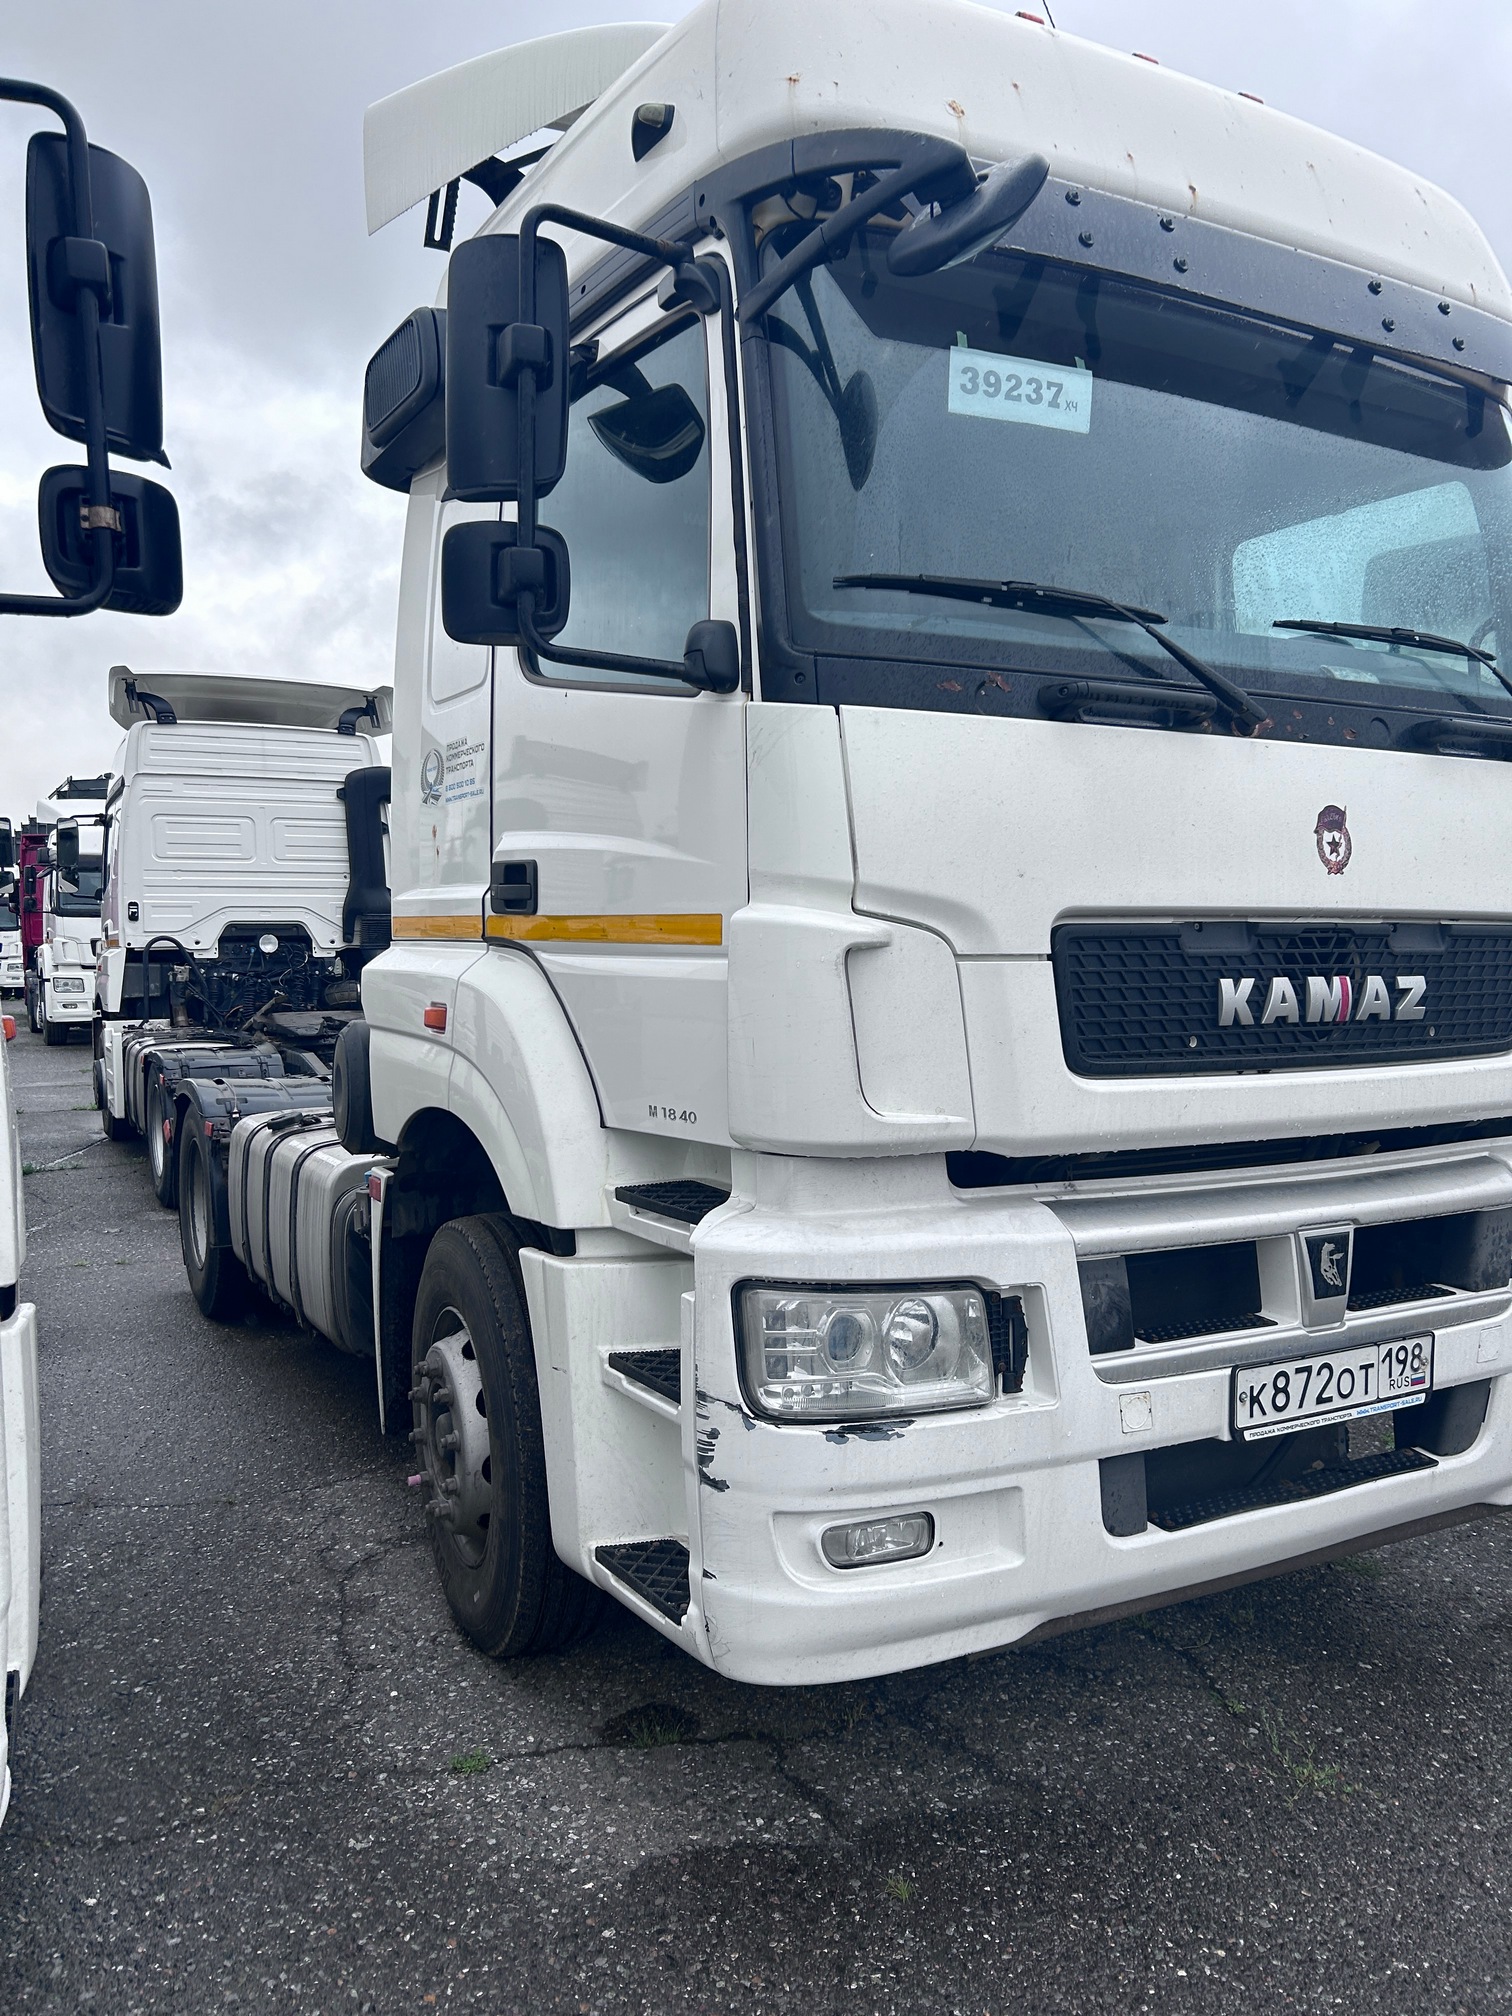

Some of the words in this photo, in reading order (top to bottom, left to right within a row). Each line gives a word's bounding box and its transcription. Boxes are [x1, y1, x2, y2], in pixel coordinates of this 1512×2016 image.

[960, 366, 1064, 409] 39237
[1218, 975, 1427, 1027] KAMAZ
[1381, 1342, 1423, 1378] 198
[1389, 1376, 1410, 1391] RUS
[1249, 1428, 1276, 1438] ПРОДАЖА
[1276, 1419, 1320, 1432] КОММЕРЧЕСКОГО
[1321, 1412, 1353, 1425] ТРАНСПОРТА
